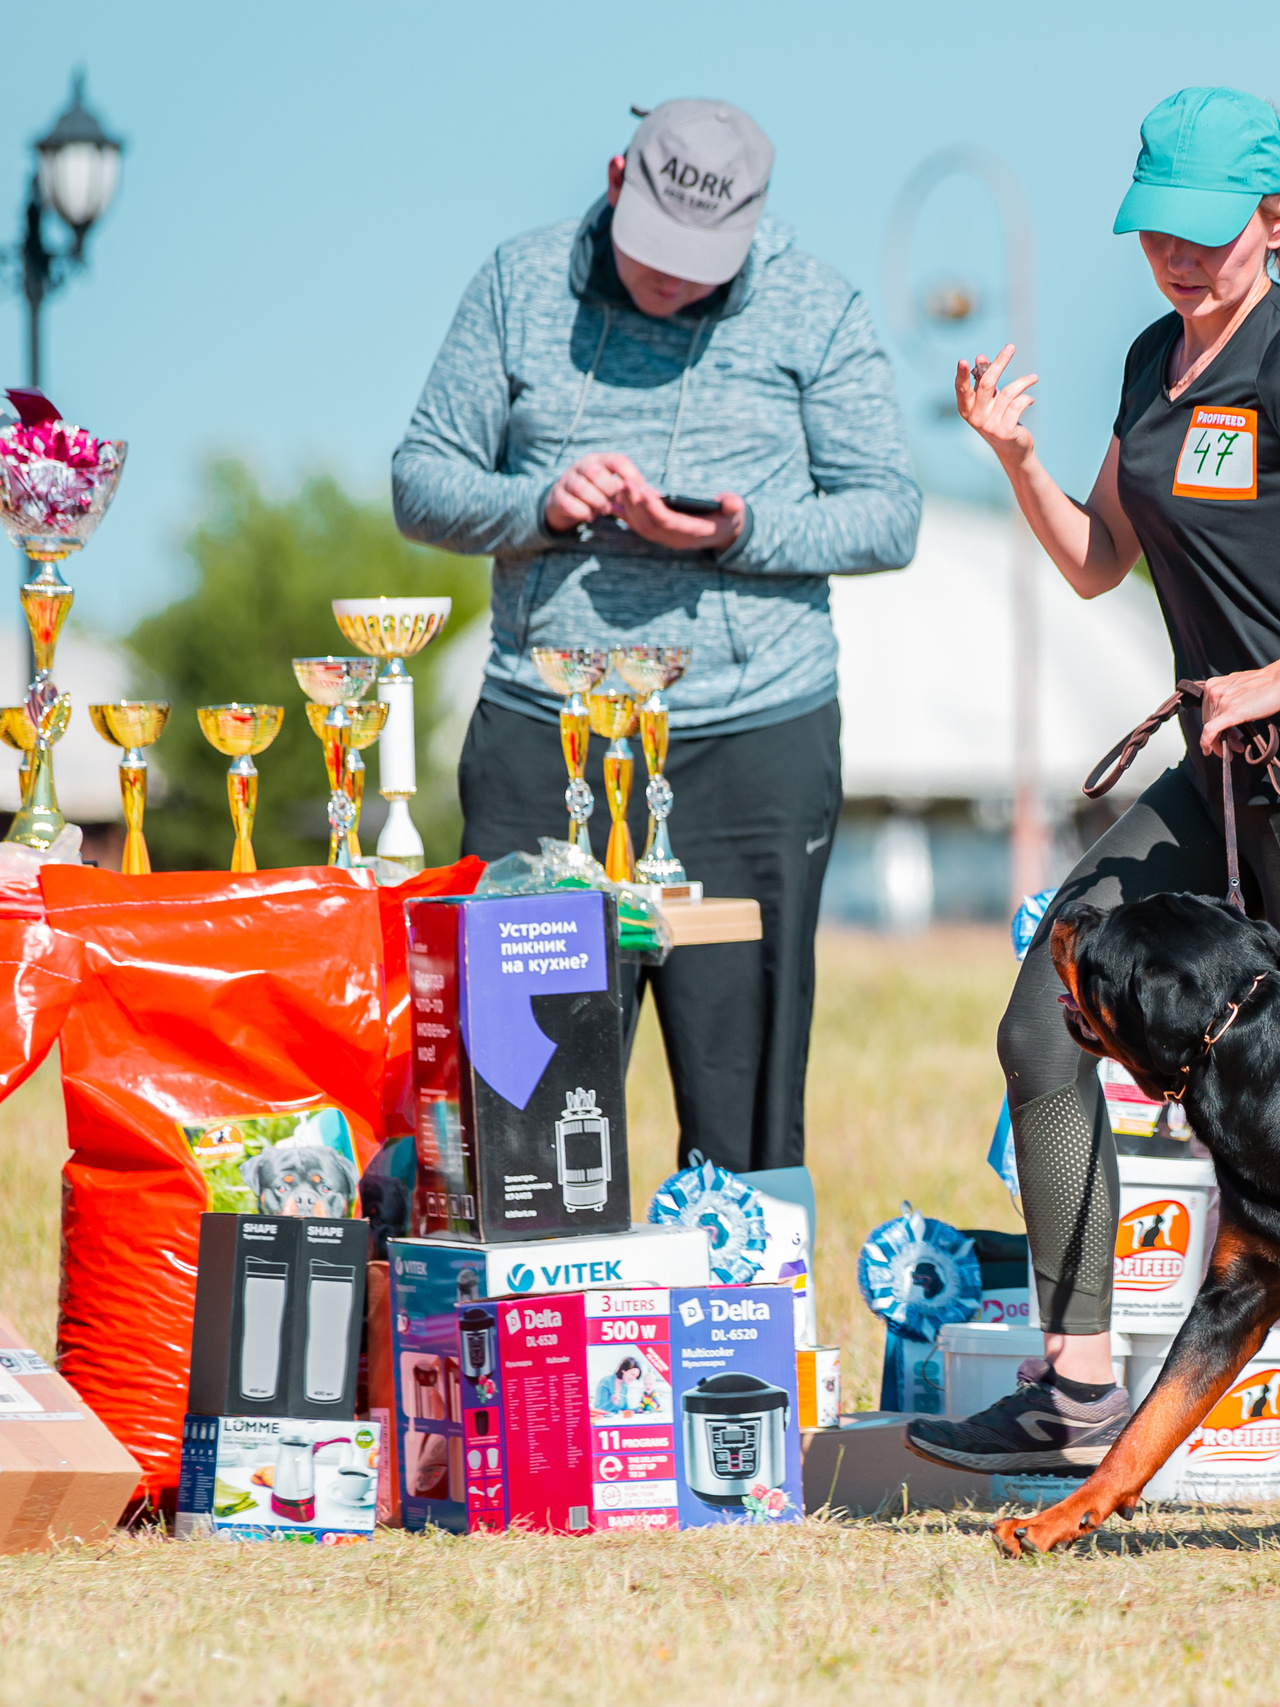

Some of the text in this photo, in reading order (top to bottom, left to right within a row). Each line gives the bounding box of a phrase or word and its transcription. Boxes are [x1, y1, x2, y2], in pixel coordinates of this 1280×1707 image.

[660, 154, 735, 200] ADRK
[1193, 430, 1239, 476] 47
[499, 920, 578, 940] Устроим
[501, 939, 567, 956] пикник
[502, 953, 589, 975] на кухне?
[242, 1222, 278, 1235] SHAPE
[306, 1225, 345, 1238] SHAPE
[541, 1260, 623, 1286] VITEK
[1113, 1256, 1184, 1278] OFIFEED
[602, 1295, 655, 1312] 3 LITERS
[709, 1299, 771, 1321] Delta
[523, 1309, 562, 1330] Delta
[601, 1320, 639, 1341] 500
[711, 1328, 758, 1341] DL-6520
[682, 1347, 735, 1359] Multicooker
[598, 1430, 669, 1450] 11 PROGRAMS
